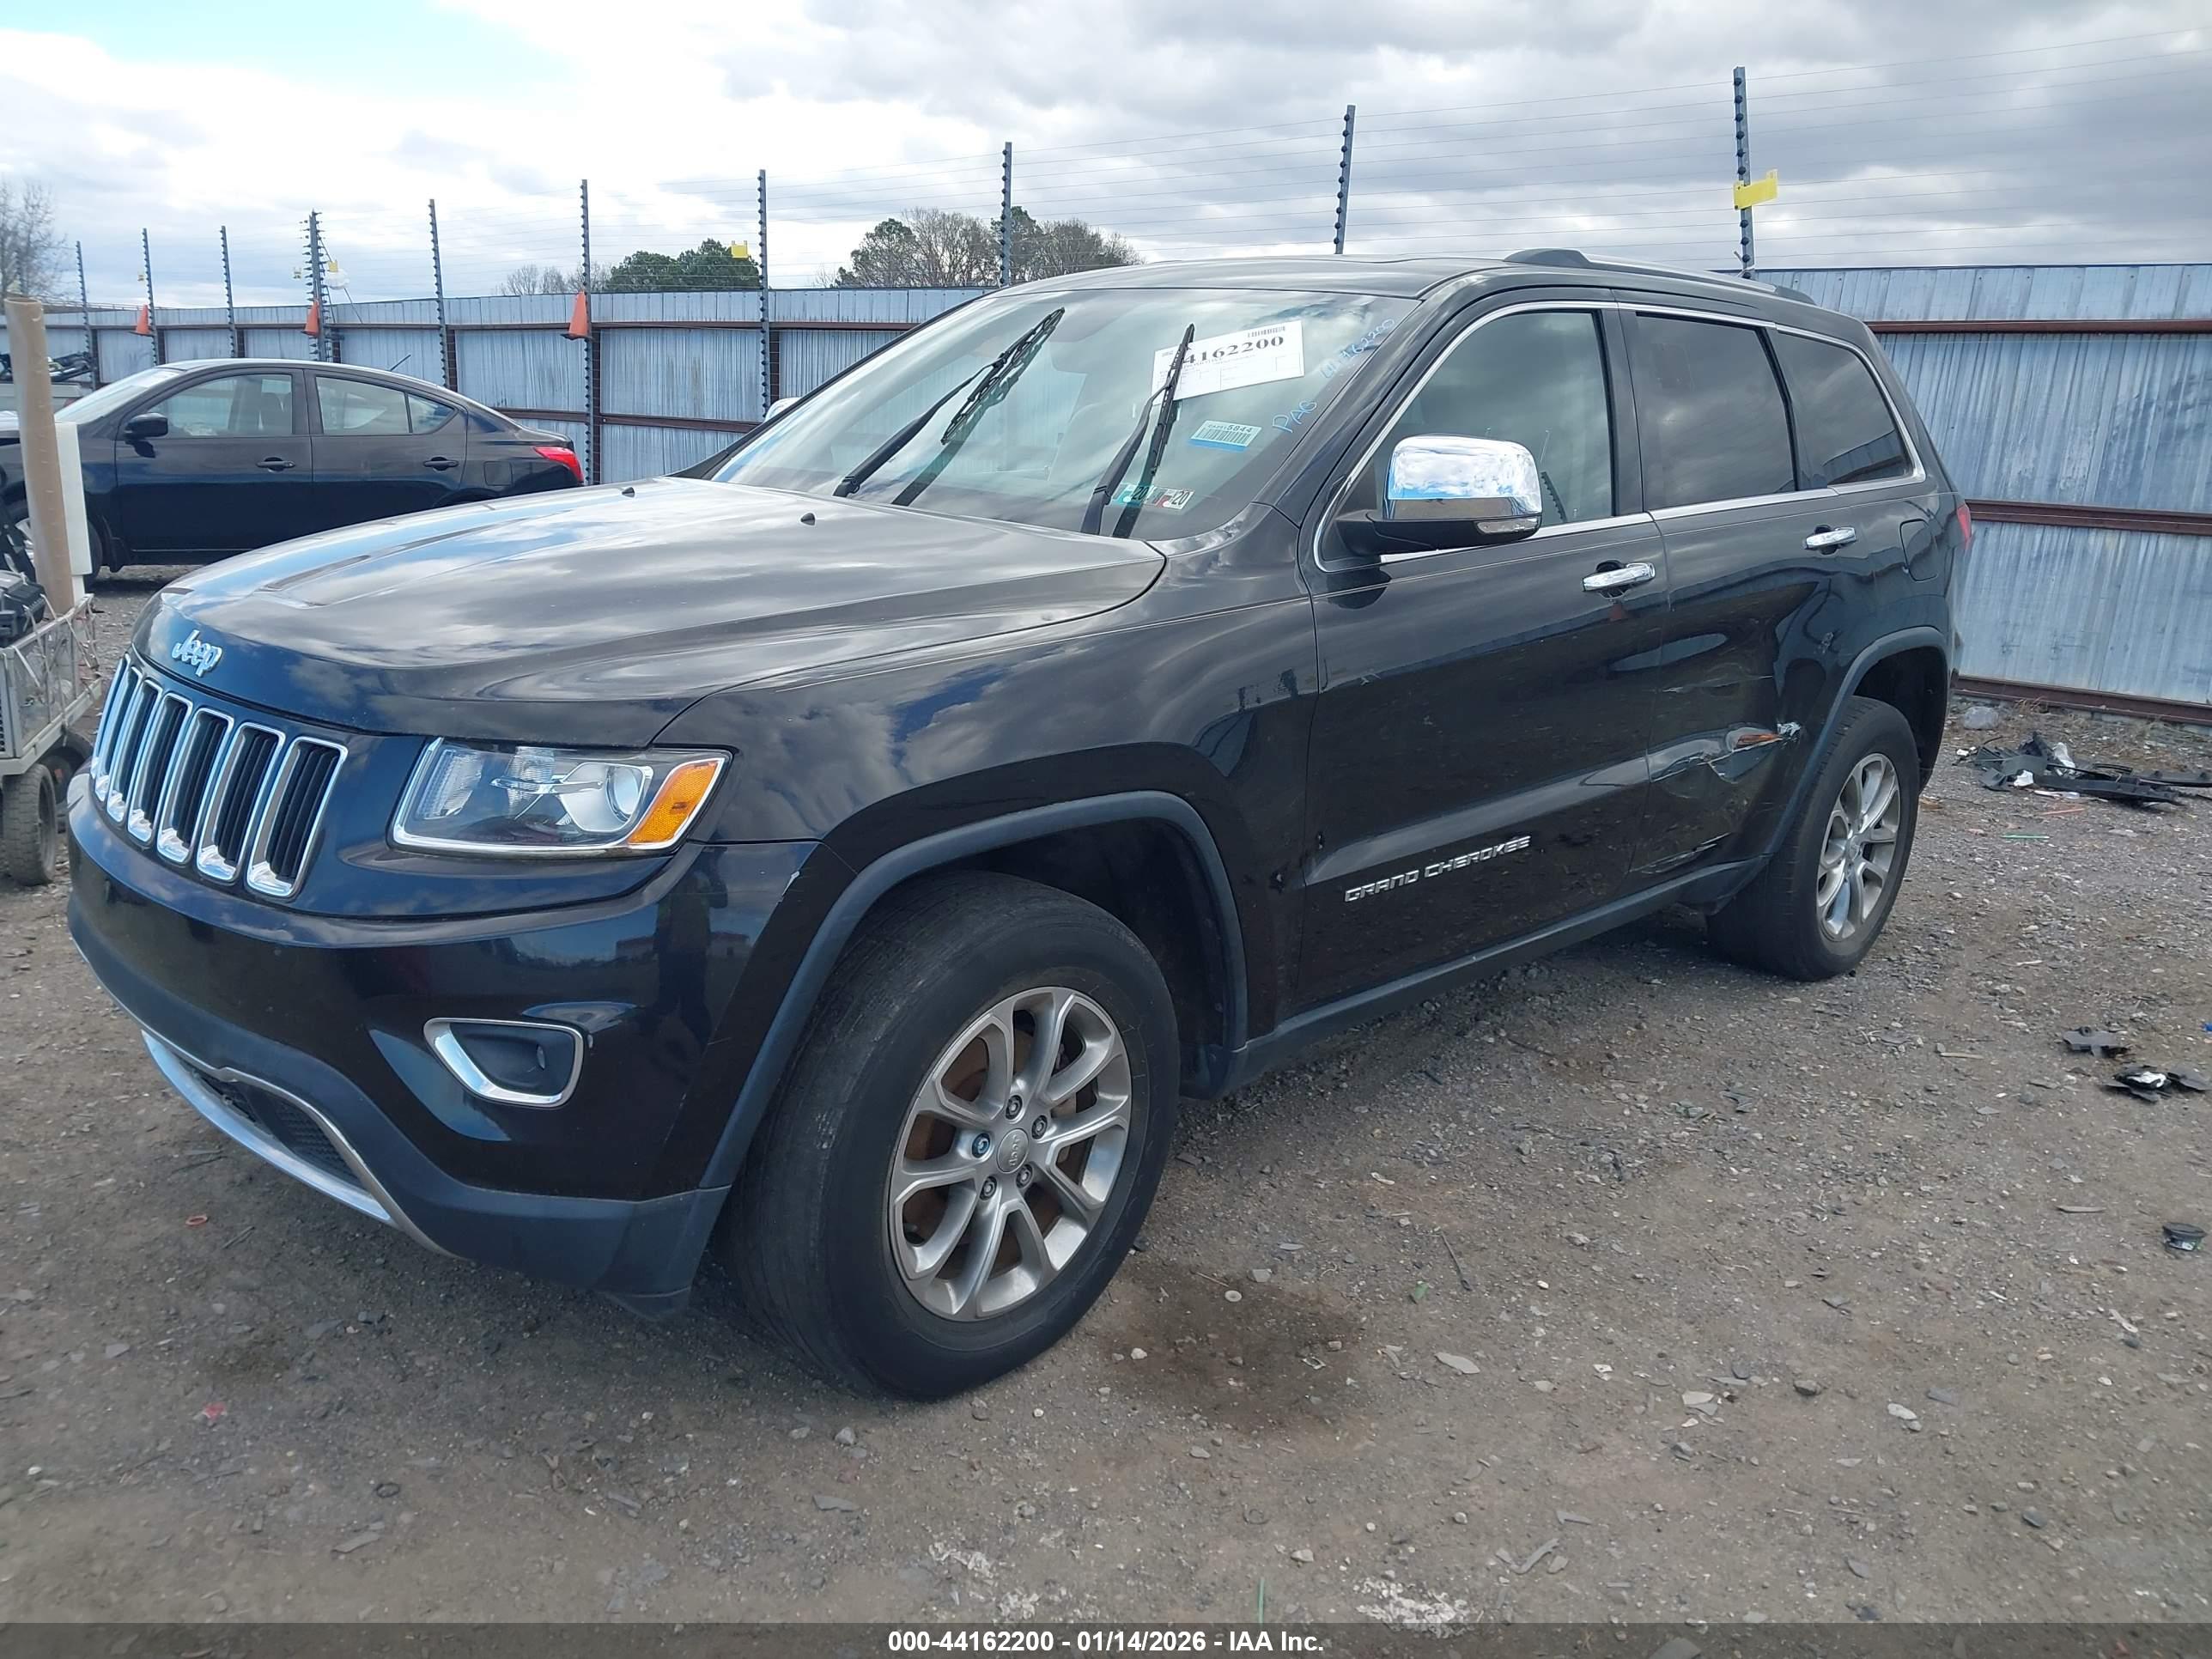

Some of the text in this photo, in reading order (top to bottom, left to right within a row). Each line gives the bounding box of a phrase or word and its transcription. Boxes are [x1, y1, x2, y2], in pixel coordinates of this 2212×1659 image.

[1169, 336, 1285, 368] 4162200
[172, 629, 222, 678] Jeep
[1345, 836, 1531, 902] GRAND CHEROKEE
